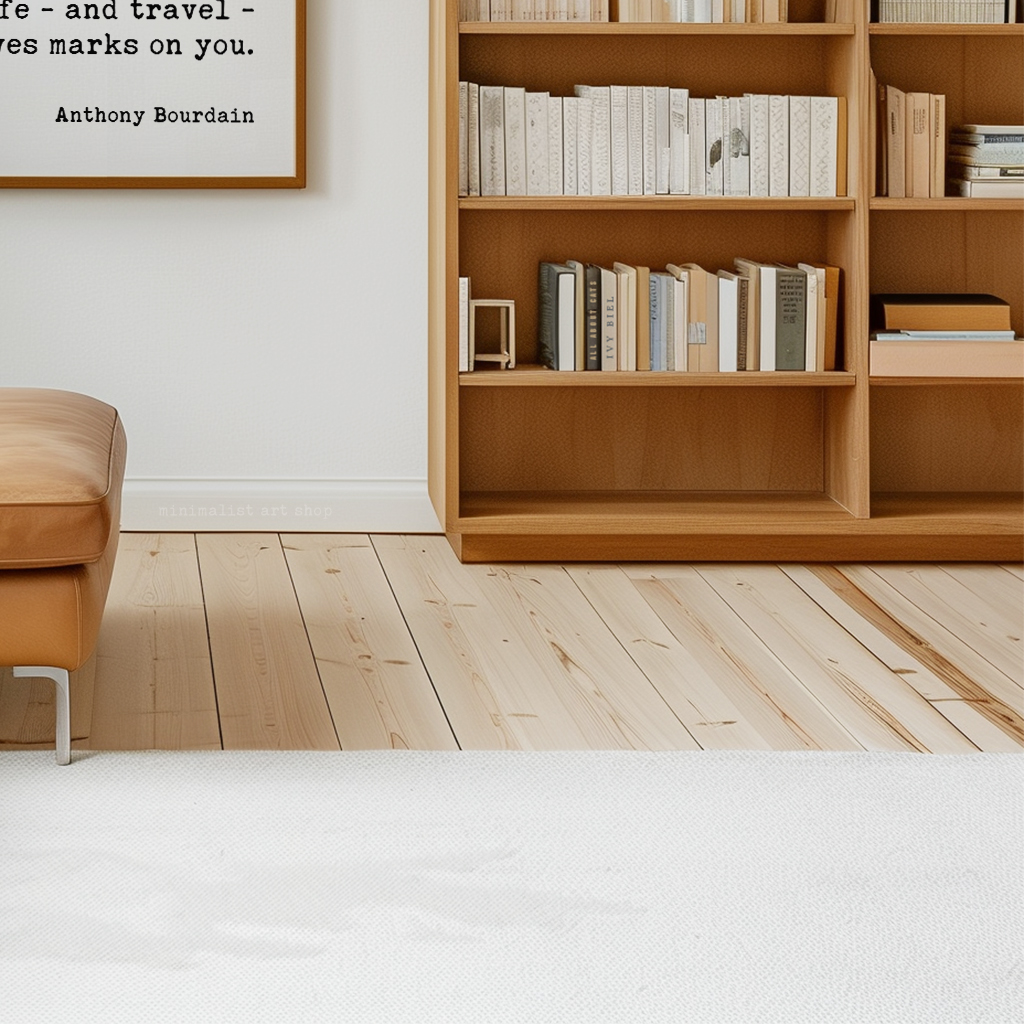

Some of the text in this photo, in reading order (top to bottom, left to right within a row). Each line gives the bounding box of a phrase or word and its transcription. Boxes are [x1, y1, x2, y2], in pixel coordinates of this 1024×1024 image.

[50, 33, 138, 54] marks
[150, 39, 182, 54] on
[195, 39, 254, 60] you.
[55, 107, 254, 126] Anthony Bourdain
[589, 280, 597, 361] ALL ABOUT CATS
[606, 296, 615, 359] IVY BIEL
